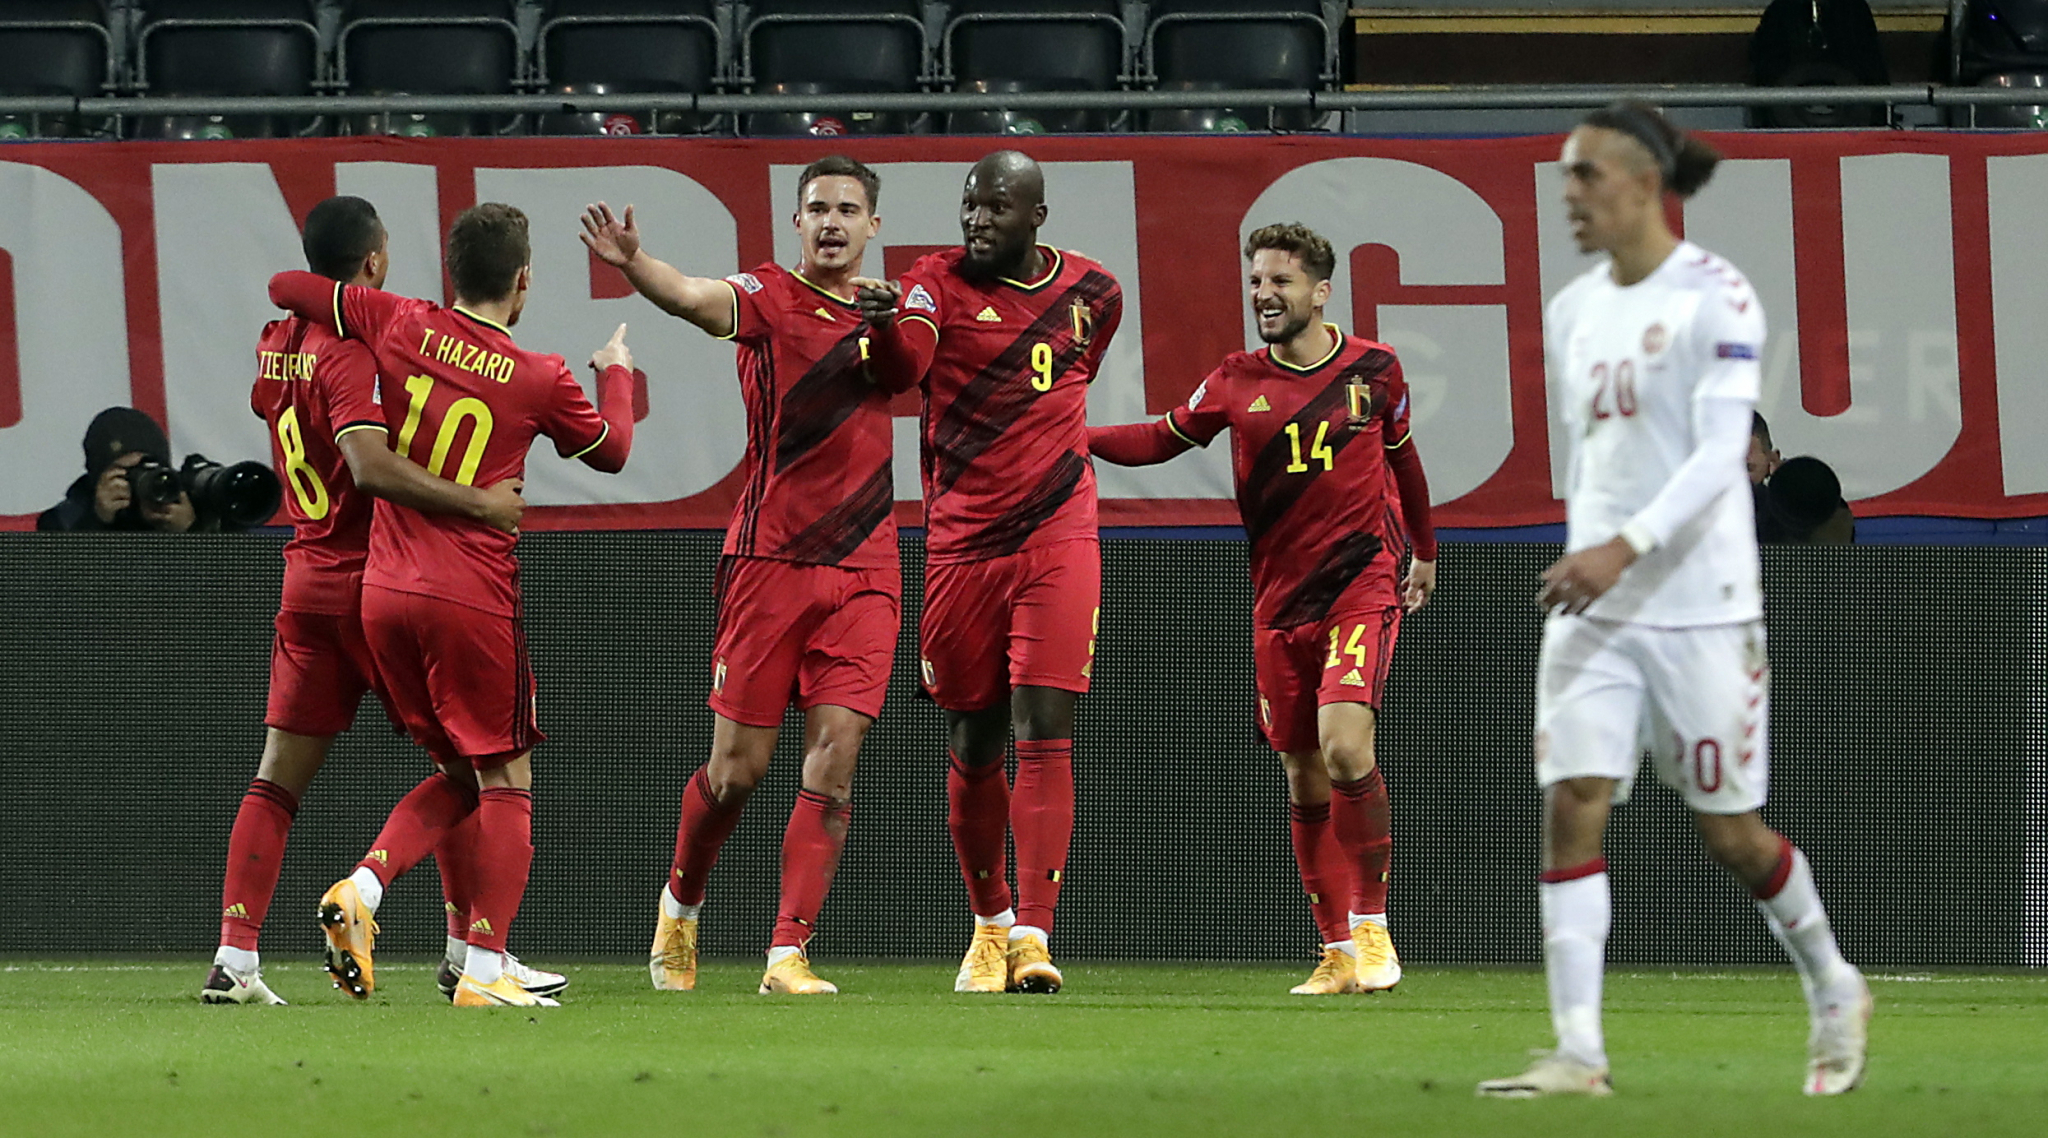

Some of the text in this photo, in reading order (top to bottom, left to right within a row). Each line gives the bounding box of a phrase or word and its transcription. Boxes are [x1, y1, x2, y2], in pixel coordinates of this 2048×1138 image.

[419, 328, 515, 384] T. HAZARD
[474, 153, 2048, 507] BLGU
[1031, 342, 1053, 392] 9
[1589, 359, 1638, 420] 20
[396, 374, 493, 487] 10
[1284, 421, 1333, 473] 14
[278, 405, 329, 520] 8
[1325, 624, 1367, 669] 14
